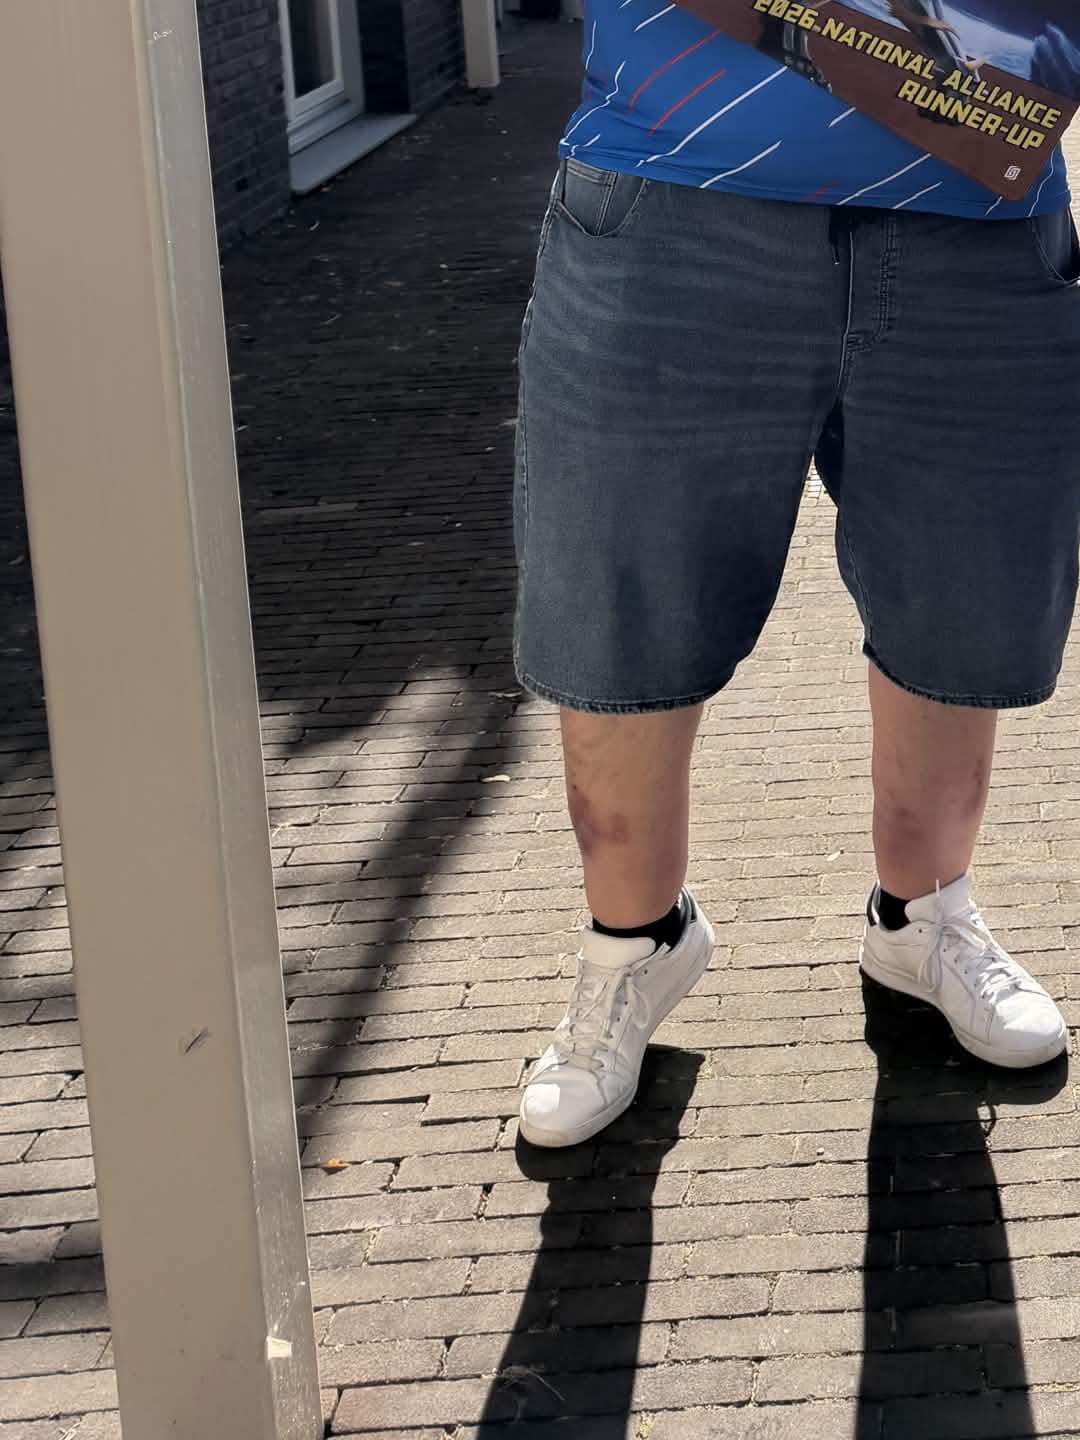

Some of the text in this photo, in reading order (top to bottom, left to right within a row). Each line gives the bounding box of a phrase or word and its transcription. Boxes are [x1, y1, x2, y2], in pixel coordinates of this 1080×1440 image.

[821, 16, 937, 81] NATIONAL
[942, 68, 1063, 130] ALLIANCE
[897, 79, 1046, 151] RUNNER-UP
